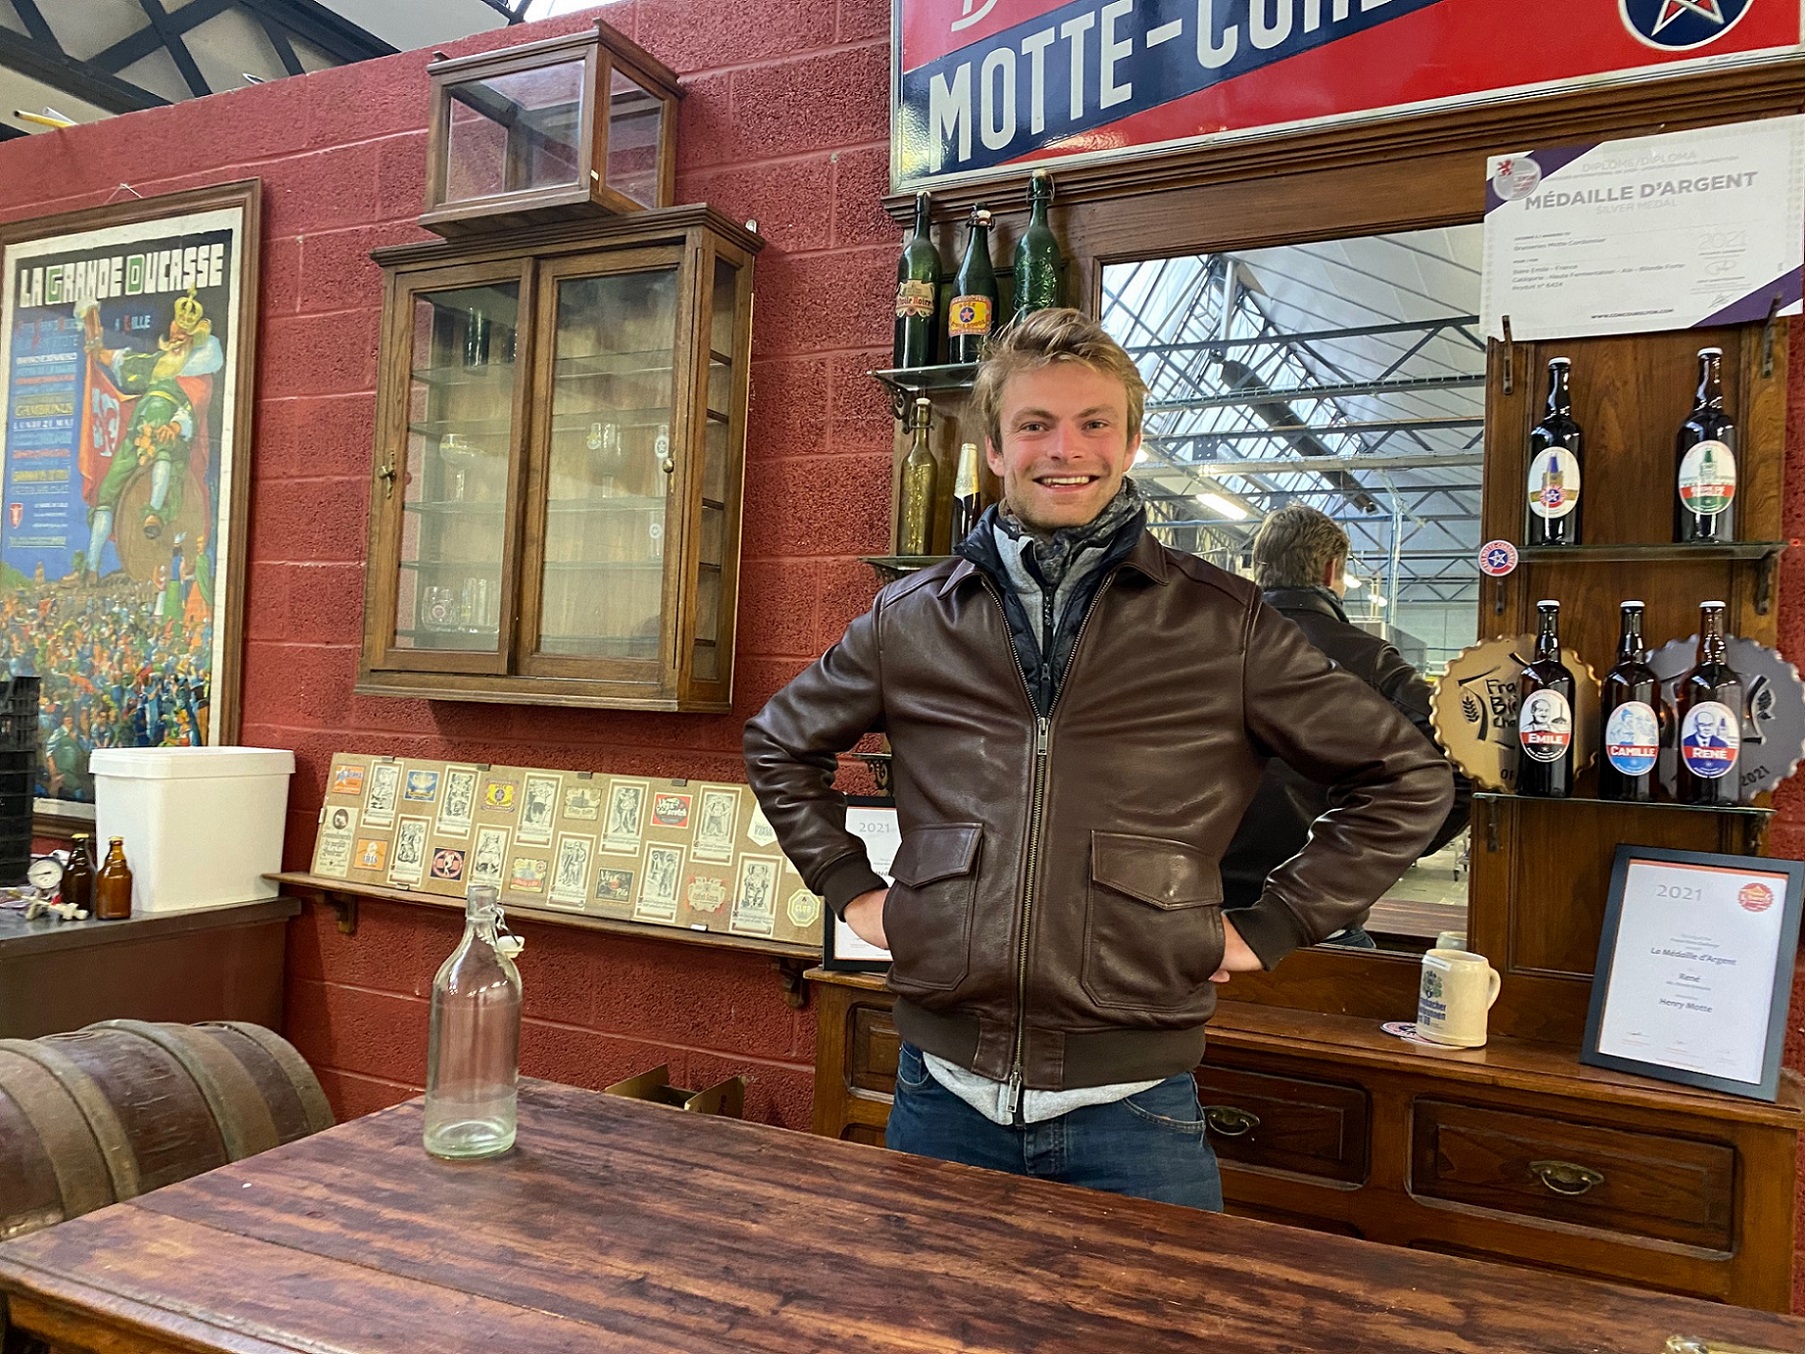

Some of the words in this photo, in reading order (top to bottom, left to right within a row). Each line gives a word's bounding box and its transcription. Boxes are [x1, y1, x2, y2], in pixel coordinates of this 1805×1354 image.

[930, 0, 1393, 174] MOTTE-CO
[1525, 186, 1634, 211] MÉDAILLE
[1640, 171, 1759, 198] D'ARGENT
[19, 267, 43, 308] LA
[45, 256, 123, 305] GRANDE
[125, 243, 224, 295] DUCASSE
[1528, 733, 1563, 744] EMILE
[1610, 746, 1655, 757] CAMILLE
[1692, 747, 1728, 759] RENÉ
[1740, 766, 1770, 786] 2021
[859, 822, 891, 833] 2021
[1656, 884, 1702, 901] 2021
